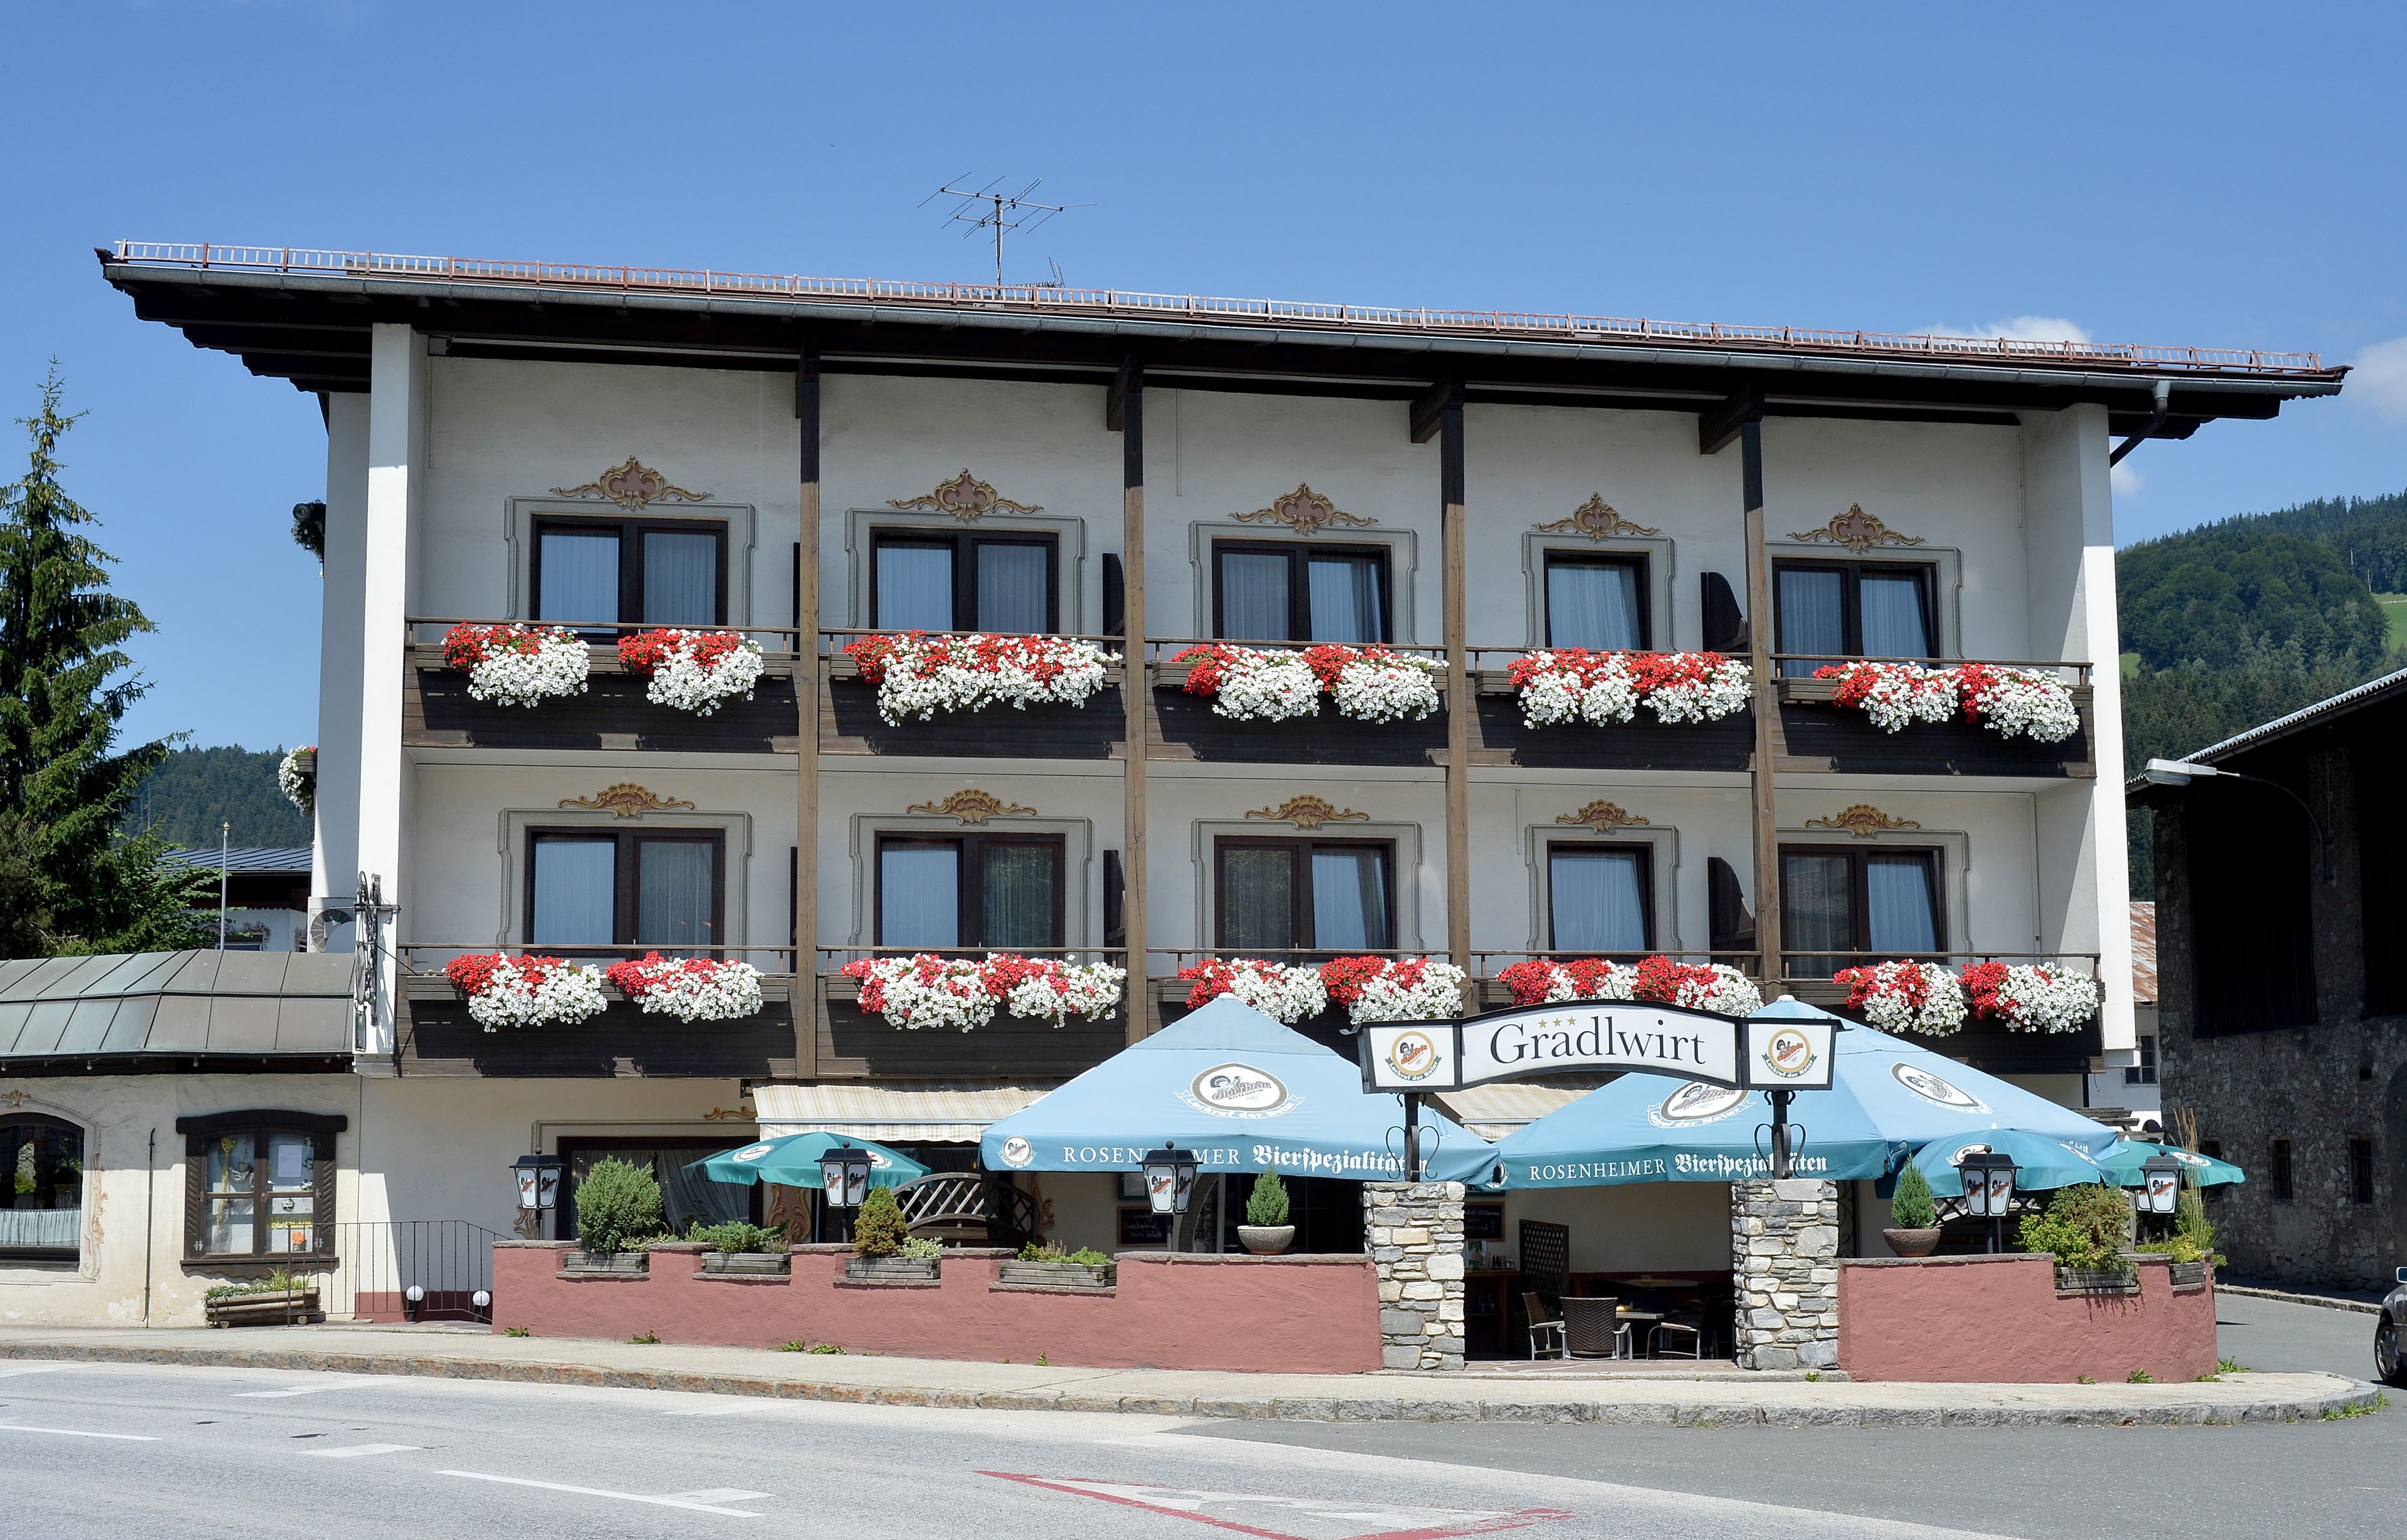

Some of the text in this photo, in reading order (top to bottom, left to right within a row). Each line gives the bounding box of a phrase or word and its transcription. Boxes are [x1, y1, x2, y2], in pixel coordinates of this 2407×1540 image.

[1491, 1016, 1706, 1064] Gradlwirt
[1389, 1062, 1410, 1081] Lockruf
[1424, 1061, 1439, 1077] Natur
[1765, 1059, 1786, 1078] Lockruf
[1800, 1059, 1814, 1075] Natur
[1212, 1081, 1272, 1101] AuerBräu
[1185, 1097, 1235, 1118] Lockruf
[1701, 1108, 1740, 1124] Natur
[1063, 1147, 1240, 1165] ROSENMER
[1253, 1145, 1429, 1174] Bierspezialitätn
[1529, 1159, 1666, 1180] ROSENHEIMER
[1675, 1153, 1827, 1178] Bierspezialäten
